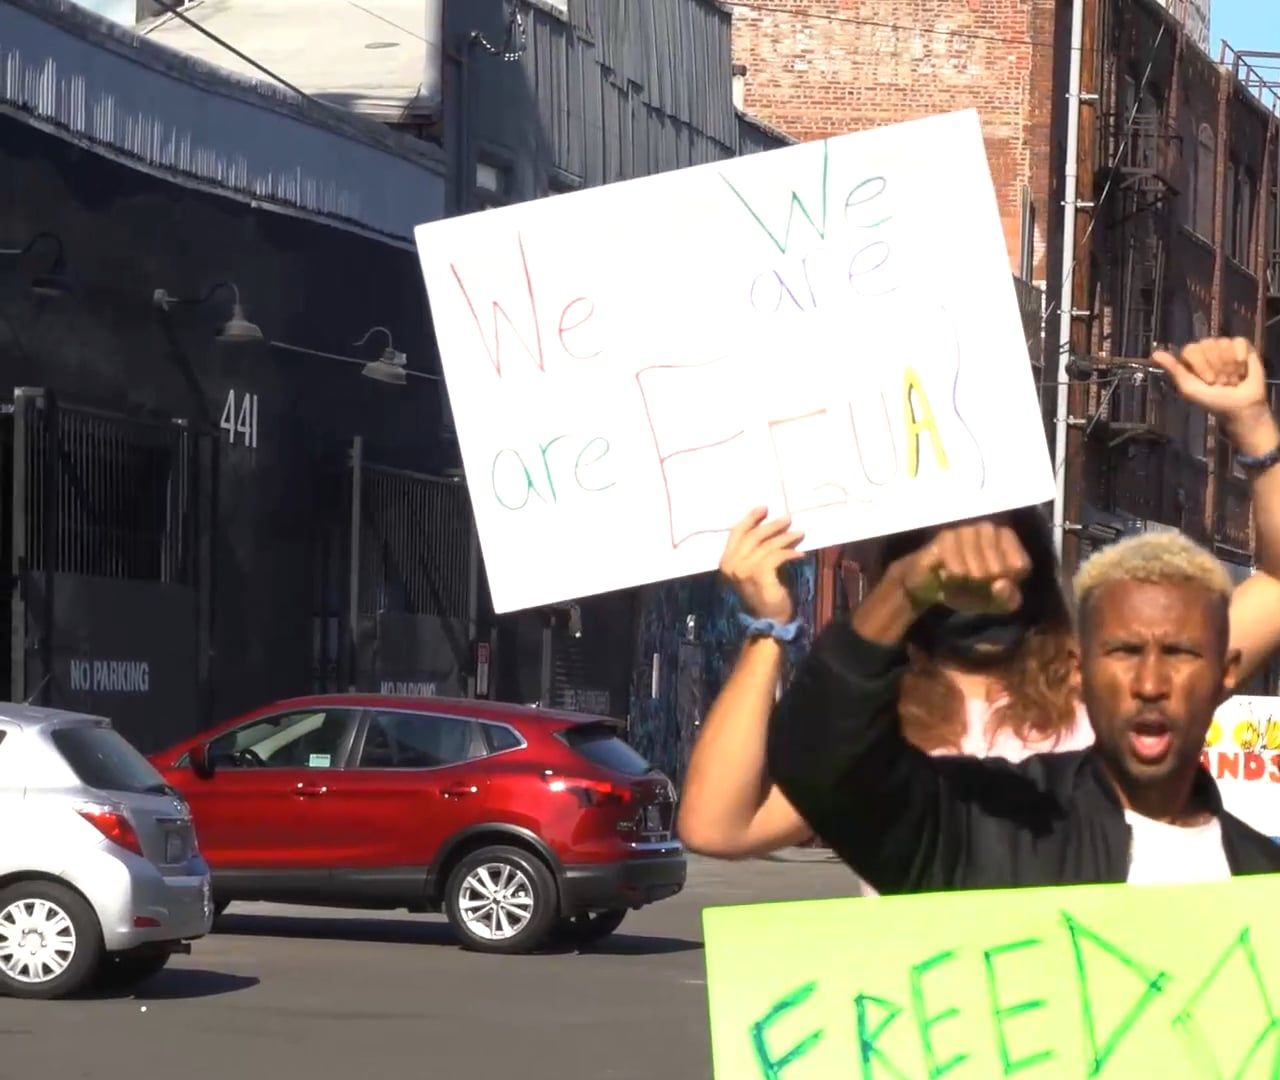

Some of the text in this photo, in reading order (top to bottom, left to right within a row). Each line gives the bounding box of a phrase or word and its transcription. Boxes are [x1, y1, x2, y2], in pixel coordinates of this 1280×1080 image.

[719, 139, 892, 254] We
[450, 231, 602, 378] We
[749, 240, 898, 312] are
[220, 389, 258, 448] 441
[491, 434, 617, 510] are
[70, 659, 149, 692] NO PARKING
